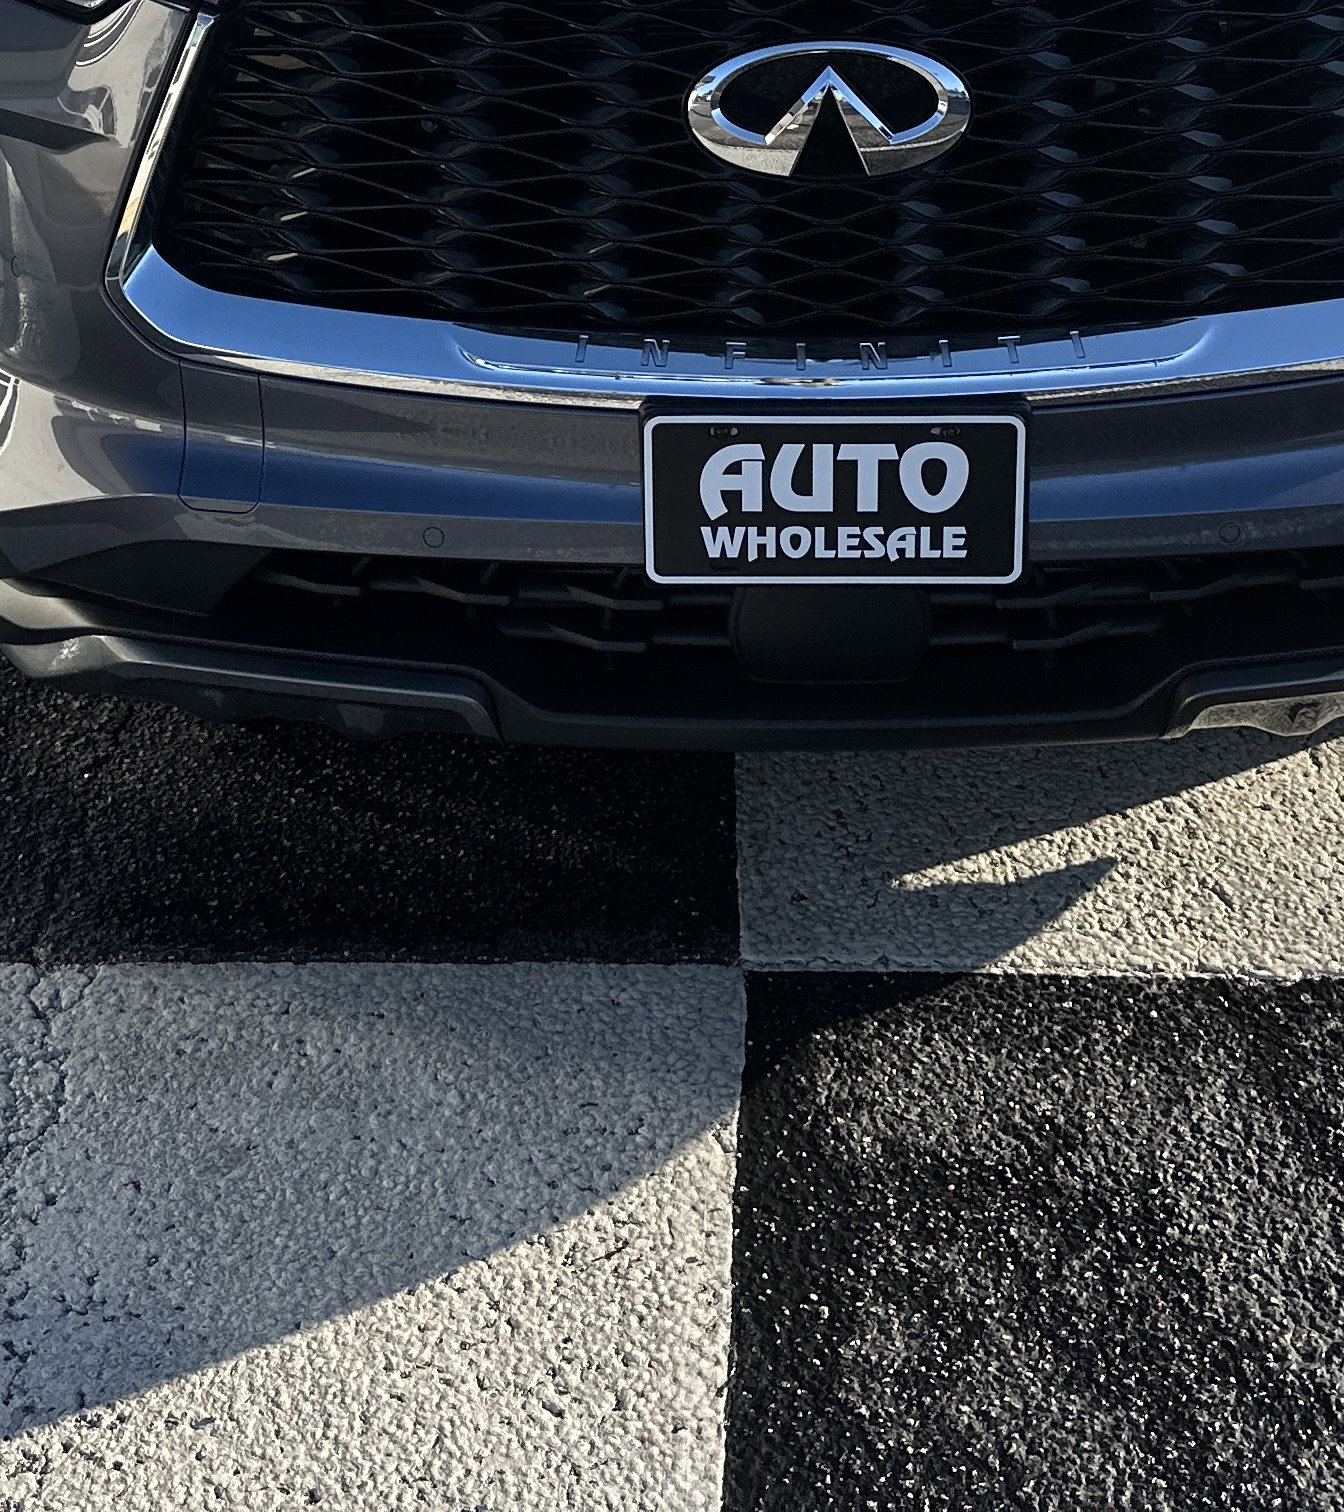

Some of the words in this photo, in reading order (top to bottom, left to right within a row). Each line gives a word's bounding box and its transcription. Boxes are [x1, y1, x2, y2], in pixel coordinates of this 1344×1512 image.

[575, 330, 1086, 371] INFINITI
[700, 442, 970, 520] AUTO
[700, 526, 967, 562] WHOLESALE
